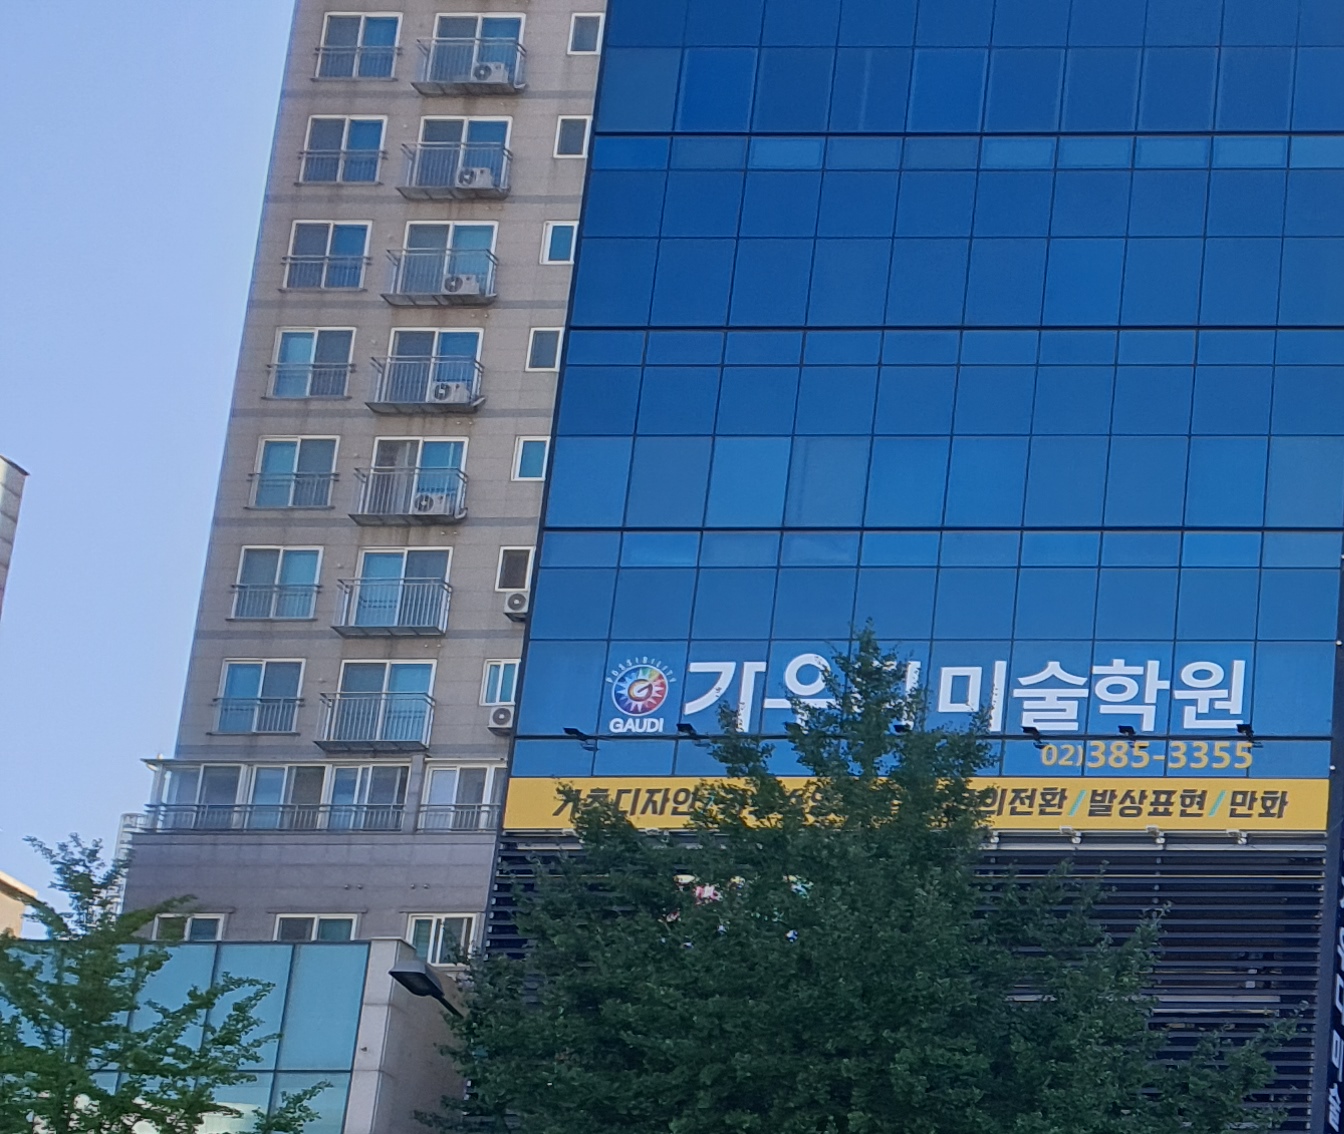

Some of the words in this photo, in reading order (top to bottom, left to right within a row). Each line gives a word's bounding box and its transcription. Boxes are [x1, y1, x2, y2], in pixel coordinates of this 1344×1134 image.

[937, 658, 1246, 733] 미술학원
[609, 716, 665, 734] GAUDI
[1040, 740, 1254, 771] 02)385-3355
[1088, 788, 1208, 817] 발상표현
[1229, 789, 1290, 818] 만화
